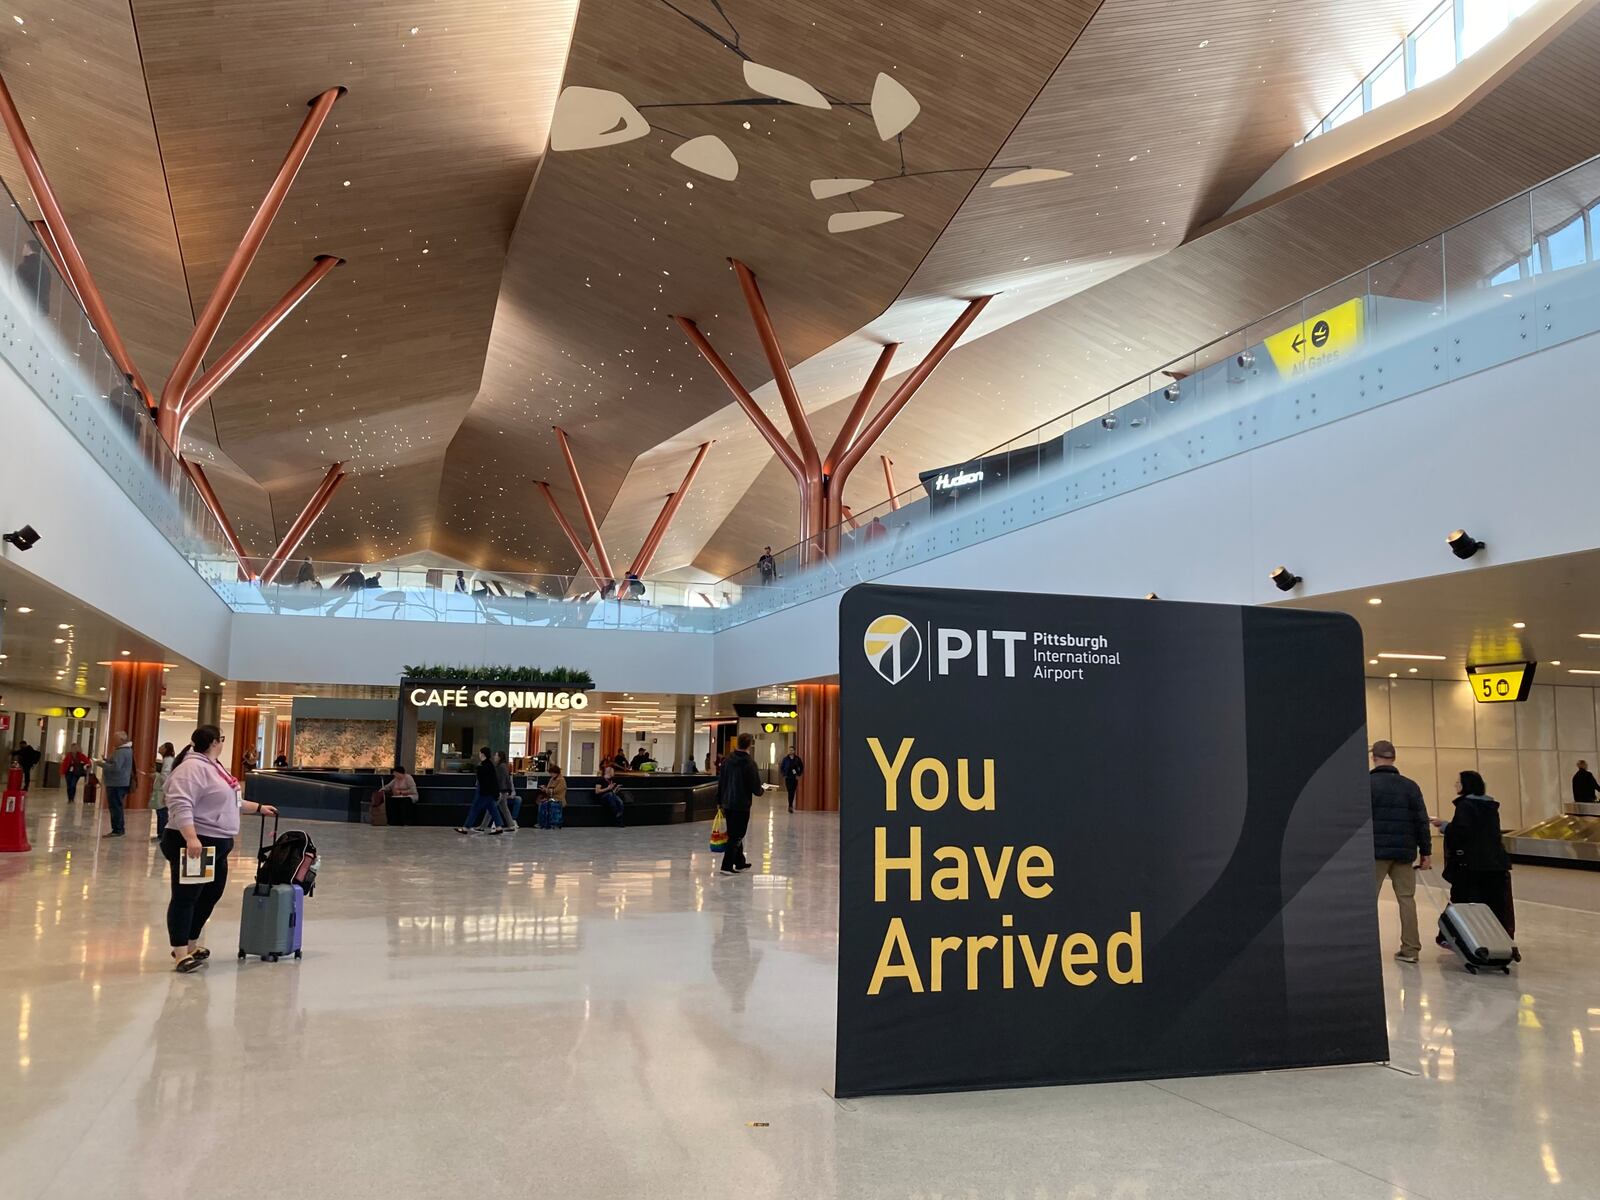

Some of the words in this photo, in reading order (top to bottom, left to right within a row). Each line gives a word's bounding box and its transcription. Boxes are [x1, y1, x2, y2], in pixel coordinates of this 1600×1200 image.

[935, 470, 984, 491] Hudson
[1033, 631, 1108, 651] Pittsburgh
[937, 627, 1027, 678] PIT
[1033, 648, 1121, 665] International
[1033, 665, 1084, 682] Airport
[410, 686, 468, 707] CAFÉ
[474, 690, 589, 710] CONMIGO
[1482, 678, 1492, 698] 5
[866, 737, 996, 812] You
[874, 826, 1055, 902] Have
[866, 911, 1143, 995] Arrived
